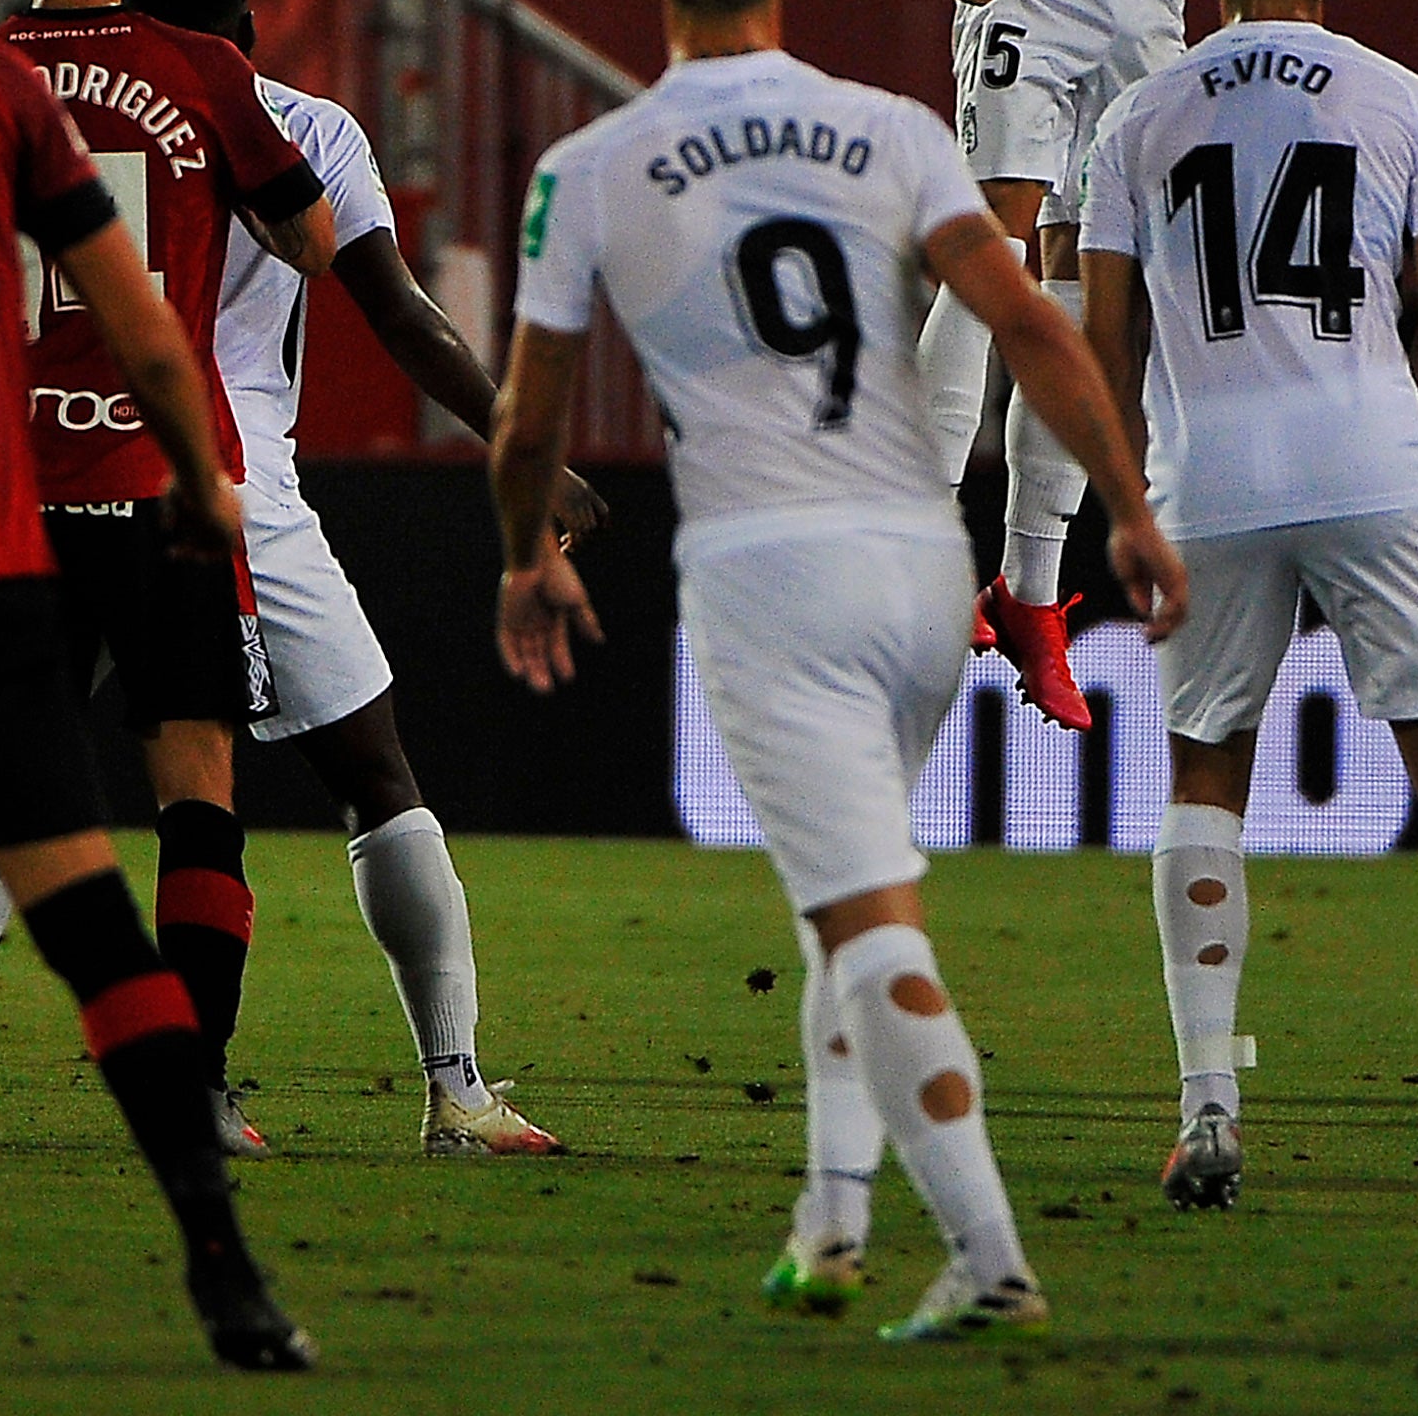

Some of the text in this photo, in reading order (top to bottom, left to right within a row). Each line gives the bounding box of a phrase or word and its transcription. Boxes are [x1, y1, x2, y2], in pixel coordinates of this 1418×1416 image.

[1201, 51, 1333, 96] F.VICO
[650, 117, 870, 195] SOLDADO
[1163, 141, 1365, 342] 14
[727, 217, 860, 430] 9
